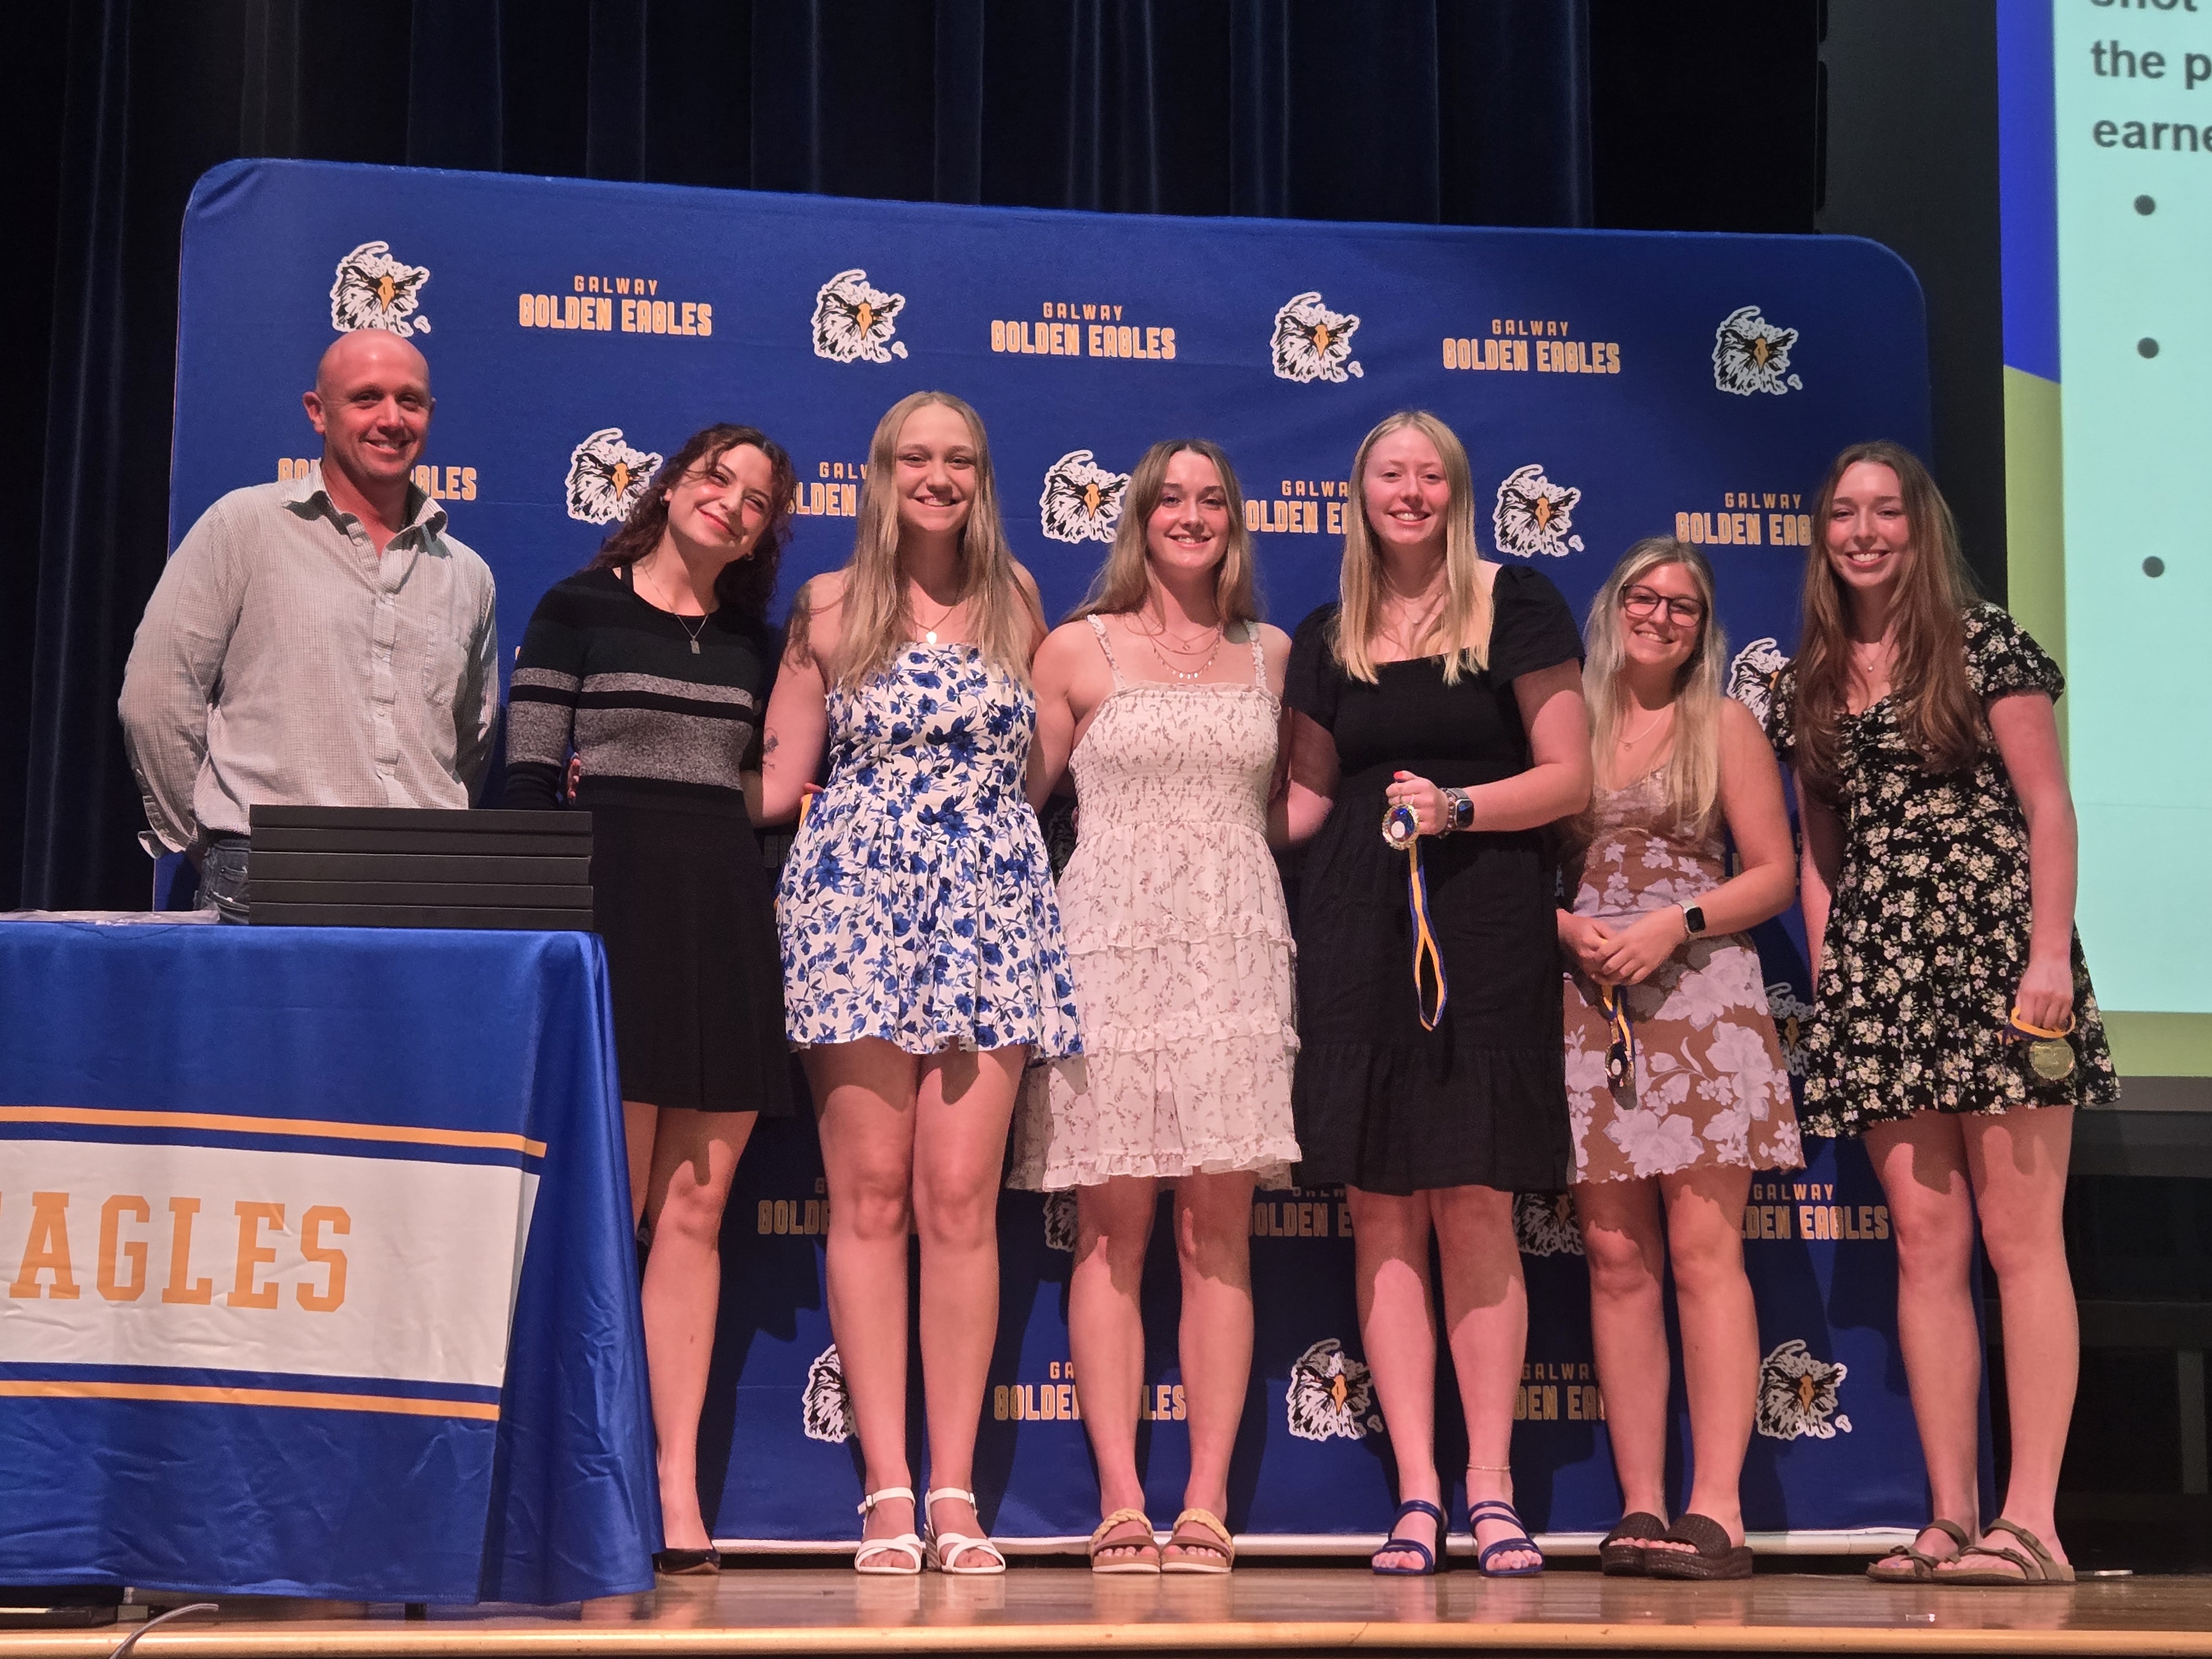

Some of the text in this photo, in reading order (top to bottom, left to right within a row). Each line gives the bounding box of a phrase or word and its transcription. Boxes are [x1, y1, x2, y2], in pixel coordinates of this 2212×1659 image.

[2090, 39, 2166, 79] the
[574, 275, 658, 296] GALWAY
[519, 294, 712, 336] GOLDEN EAGLES
[1043, 302, 1123, 321] GALWAY
[1492, 319, 1568, 336] GALWAY
[991, 320, 1176, 359] GOLDEN EAGLES
[1443, 338, 1621, 374] GOLDEN EAGLES
[410, 465, 477, 501] GLES
[819, 461, 867, 480] GAL
[787, 482, 857, 517] LDEN
[1282, 480, 1349, 497] GALWA
[1725, 492, 1801, 509] GALWAY
[1244, 500, 1318, 534] OLDEN
[1676, 512, 1813, 546] GOLDEN EAG
[1753, 1183, 1833, 1201] GALWAY
[758, 1199, 830, 1235] GOLDE
[1250, 1202, 1328, 1237] OLDEN
[1742, 1206, 1890, 1239] DEN EAGLES
[0, 1191, 352, 1313] AGLES
[1522, 1363, 1589, 1380] GALWA
[1140, 1384, 1187, 1421] LES
[1514, 1385, 1558, 1421] DEN
